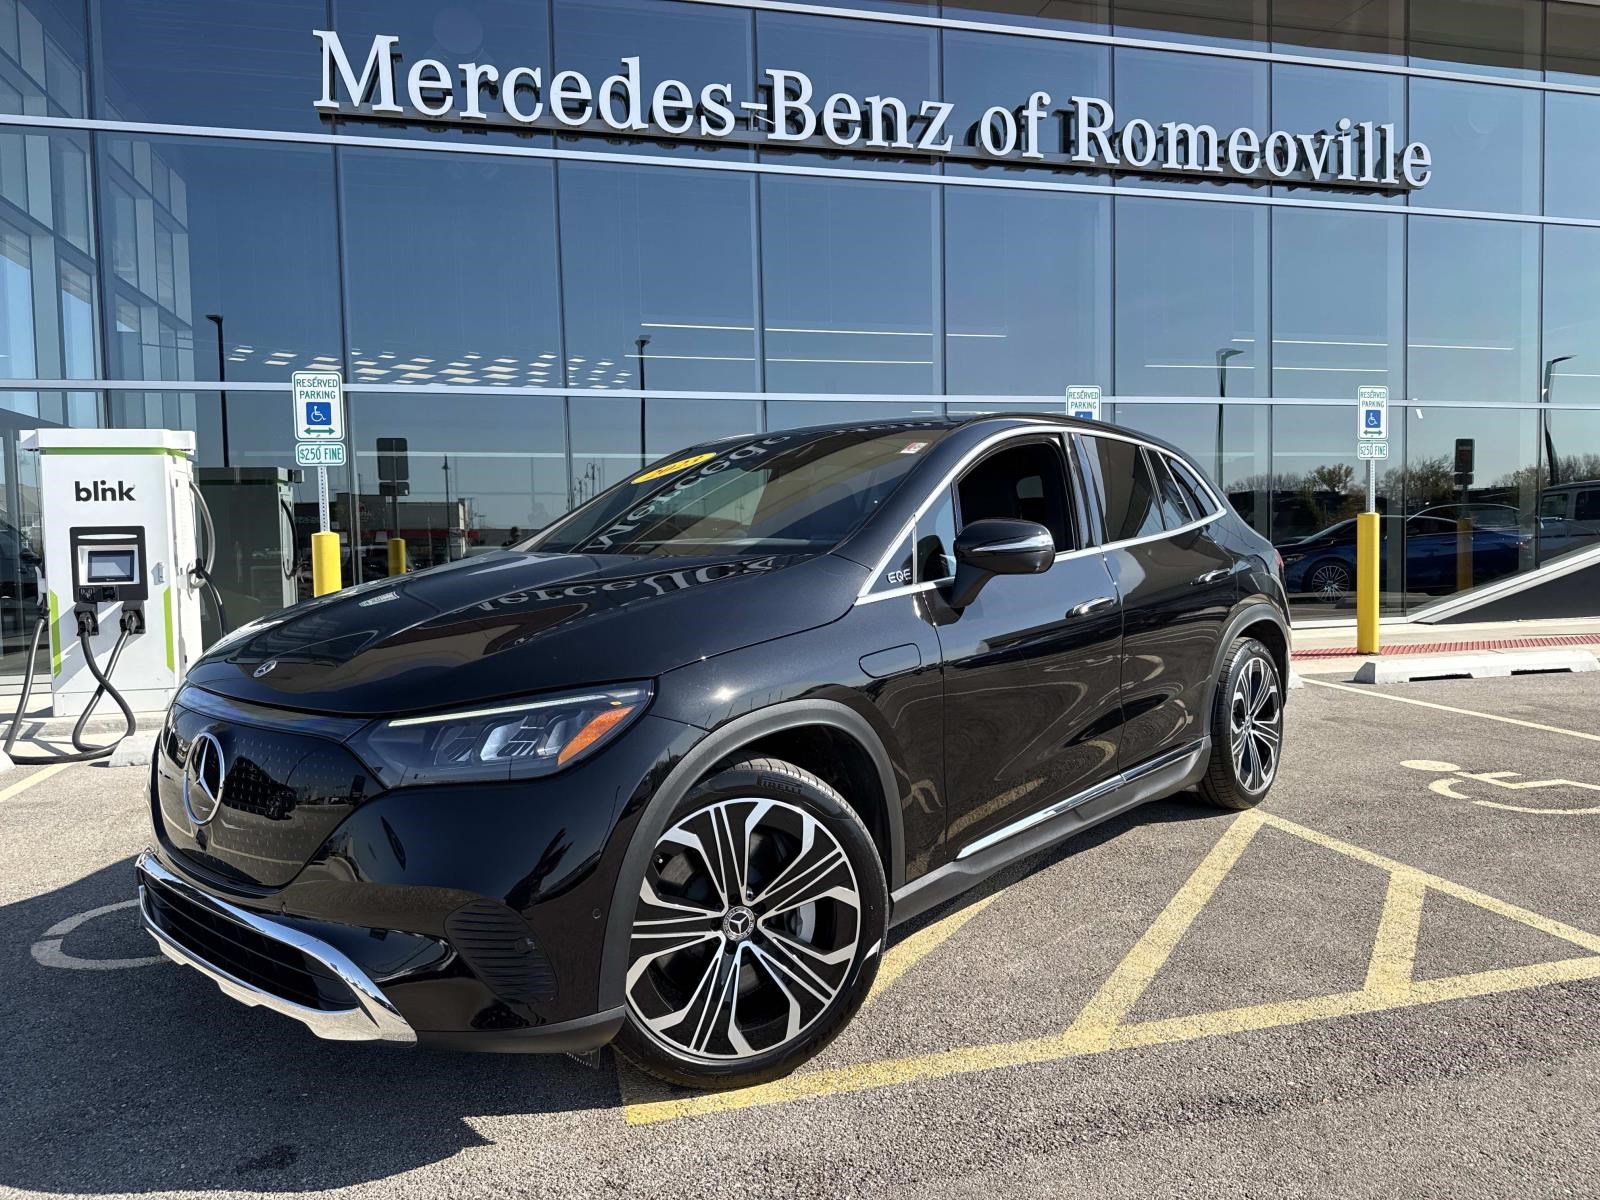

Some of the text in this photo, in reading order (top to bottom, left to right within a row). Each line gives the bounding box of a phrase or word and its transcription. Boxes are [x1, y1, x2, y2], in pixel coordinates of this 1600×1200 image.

[312, 29, 1432, 188] Mercedes-Benz of Romeoville
[296, 378, 338, 388] RESERVED
[299, 390, 336, 400] PARKING
[1068, 391, 1099, 400] RESERVED
[1360, 391, 1386, 399] RESERVED
[1070, 401, 1097, 410] PARKING
[1361, 400, 1385, 408] PARKING
[299, 447, 342, 461] $250 FINE
[1360, 445, 1386, 456] $250 FINE
[74, 479, 137, 502] blink
[887, 568, 912, 584] EQE
